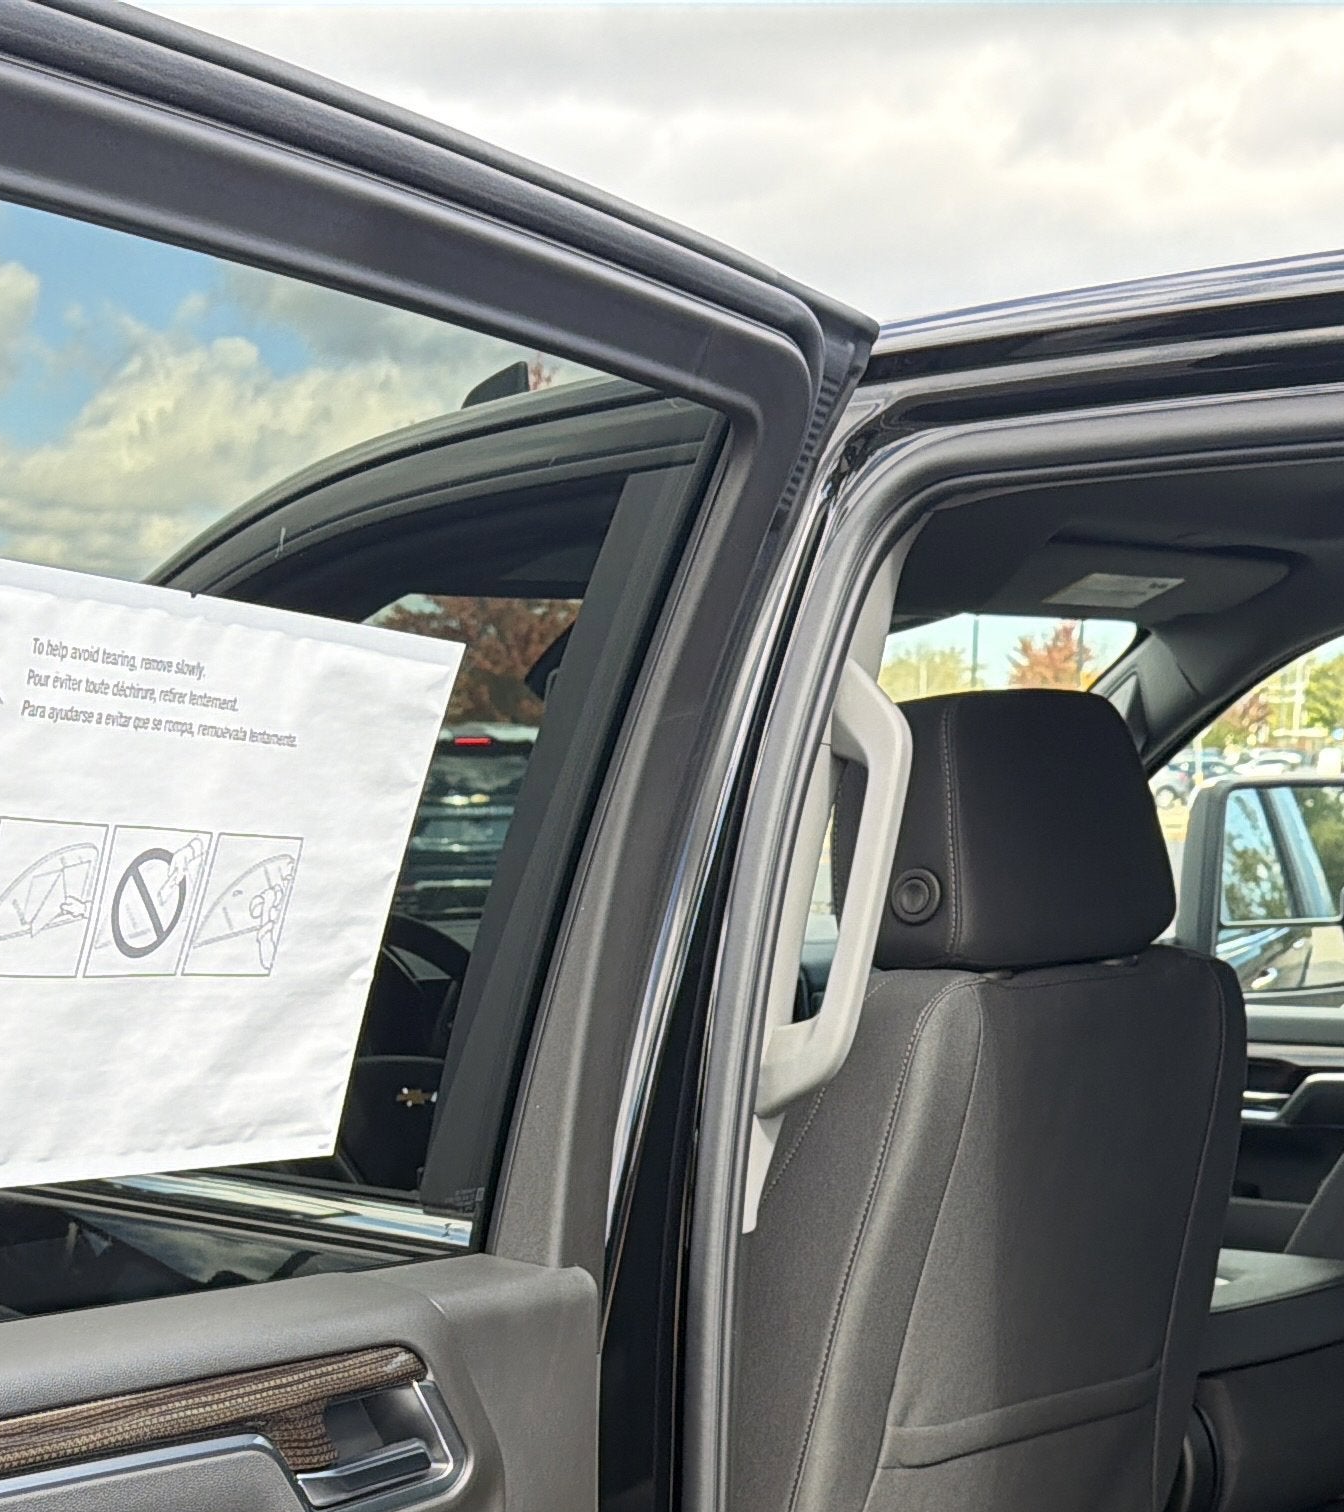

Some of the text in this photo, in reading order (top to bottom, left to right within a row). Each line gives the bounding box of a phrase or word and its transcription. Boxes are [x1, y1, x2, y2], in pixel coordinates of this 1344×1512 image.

[32, 637, 206, 681] To help avoid tearing, remove slowly.
[27, 668, 50, 687] Pour
[85, 677, 110, 696] toute
[159, 687, 187, 705] retirer
[188, 690, 239, 712] lentement.
[21, 700, 46, 719] Para
[47, 705, 94, 724] ayudarse
[95, 711, 103, 725] a
[105, 711, 132, 728] evitar
[132, 716, 150, 731] que
[151, 717, 162, 731] se
